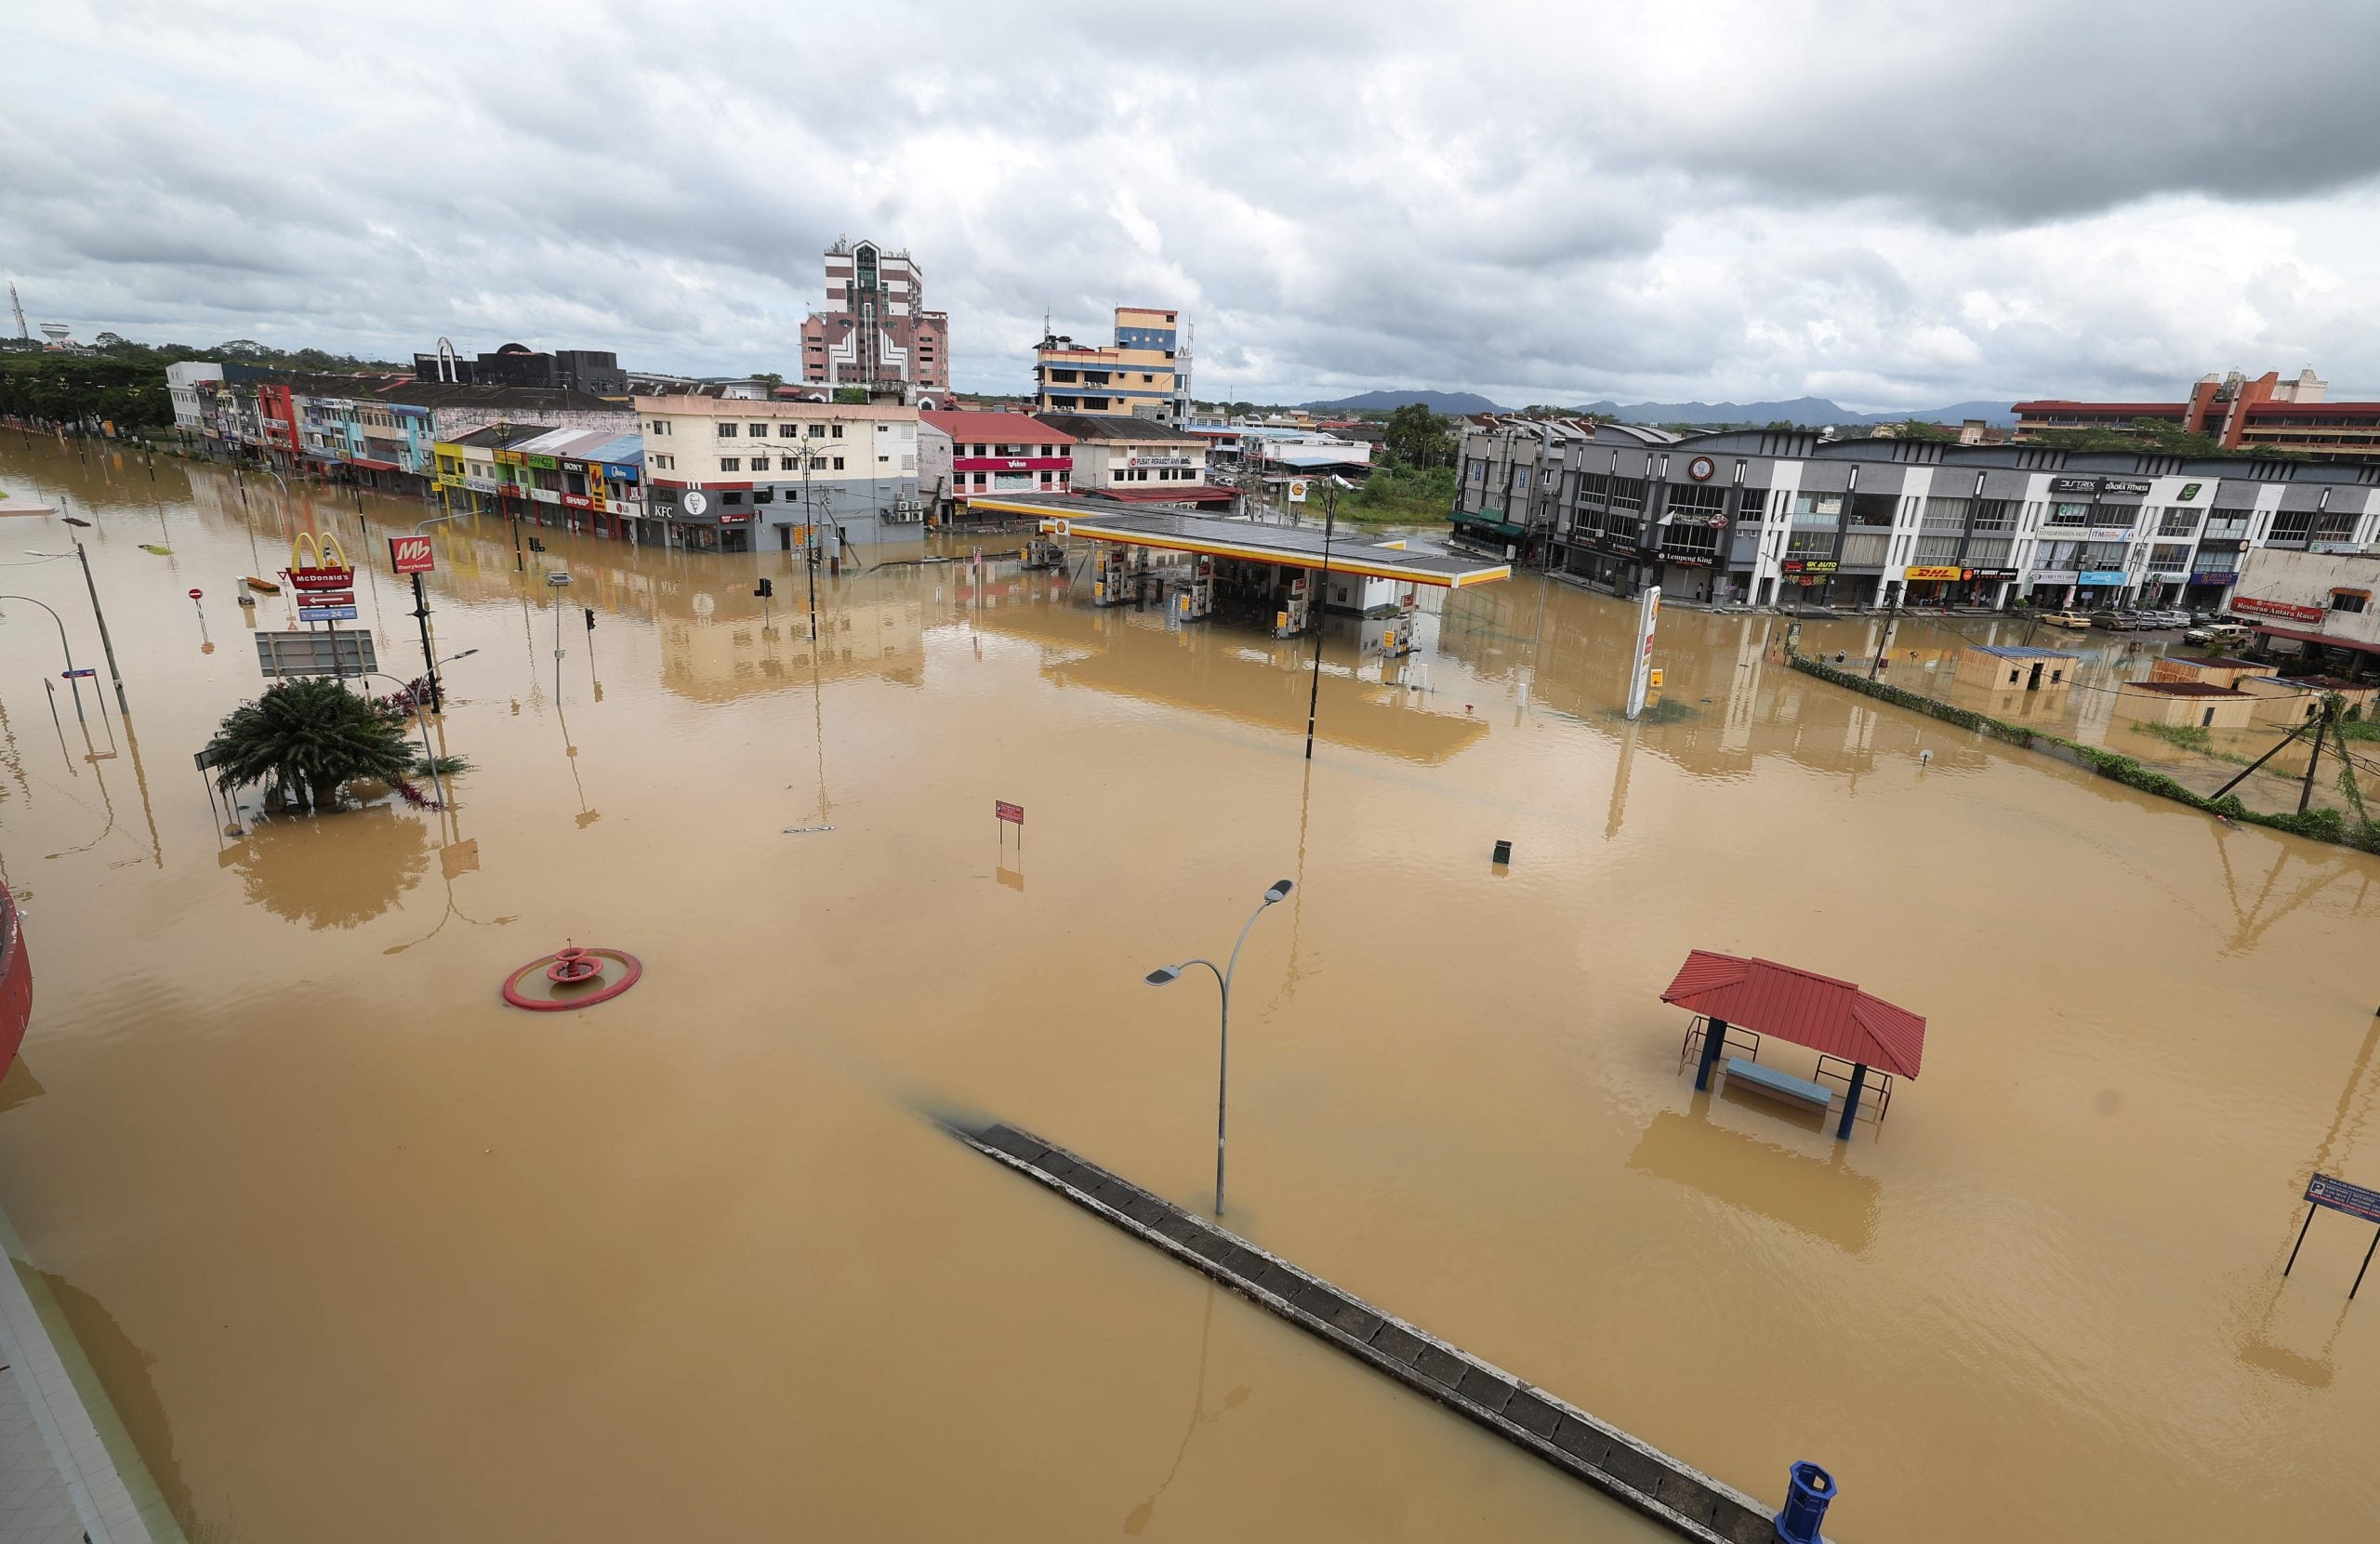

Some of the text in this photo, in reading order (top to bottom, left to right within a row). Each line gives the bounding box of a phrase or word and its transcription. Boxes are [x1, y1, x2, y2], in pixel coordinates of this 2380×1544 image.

[563, 462, 583, 472] SONY
[565, 496, 589, 507] SHARP
[654, 505, 673, 519] KFC
[396, 540, 430, 561] Mb
[1667, 553, 1697, 563] Lempeng
[1918, 568, 1950, 577] DHL
[297, 574, 349, 583] McDonald's
[330, 611, 342, 619] 24
[2237, 601, 2268, 613] Restoran
[2269, 607, 2294, 617] Antara
[2296, 611, 2315, 620] Rasa
